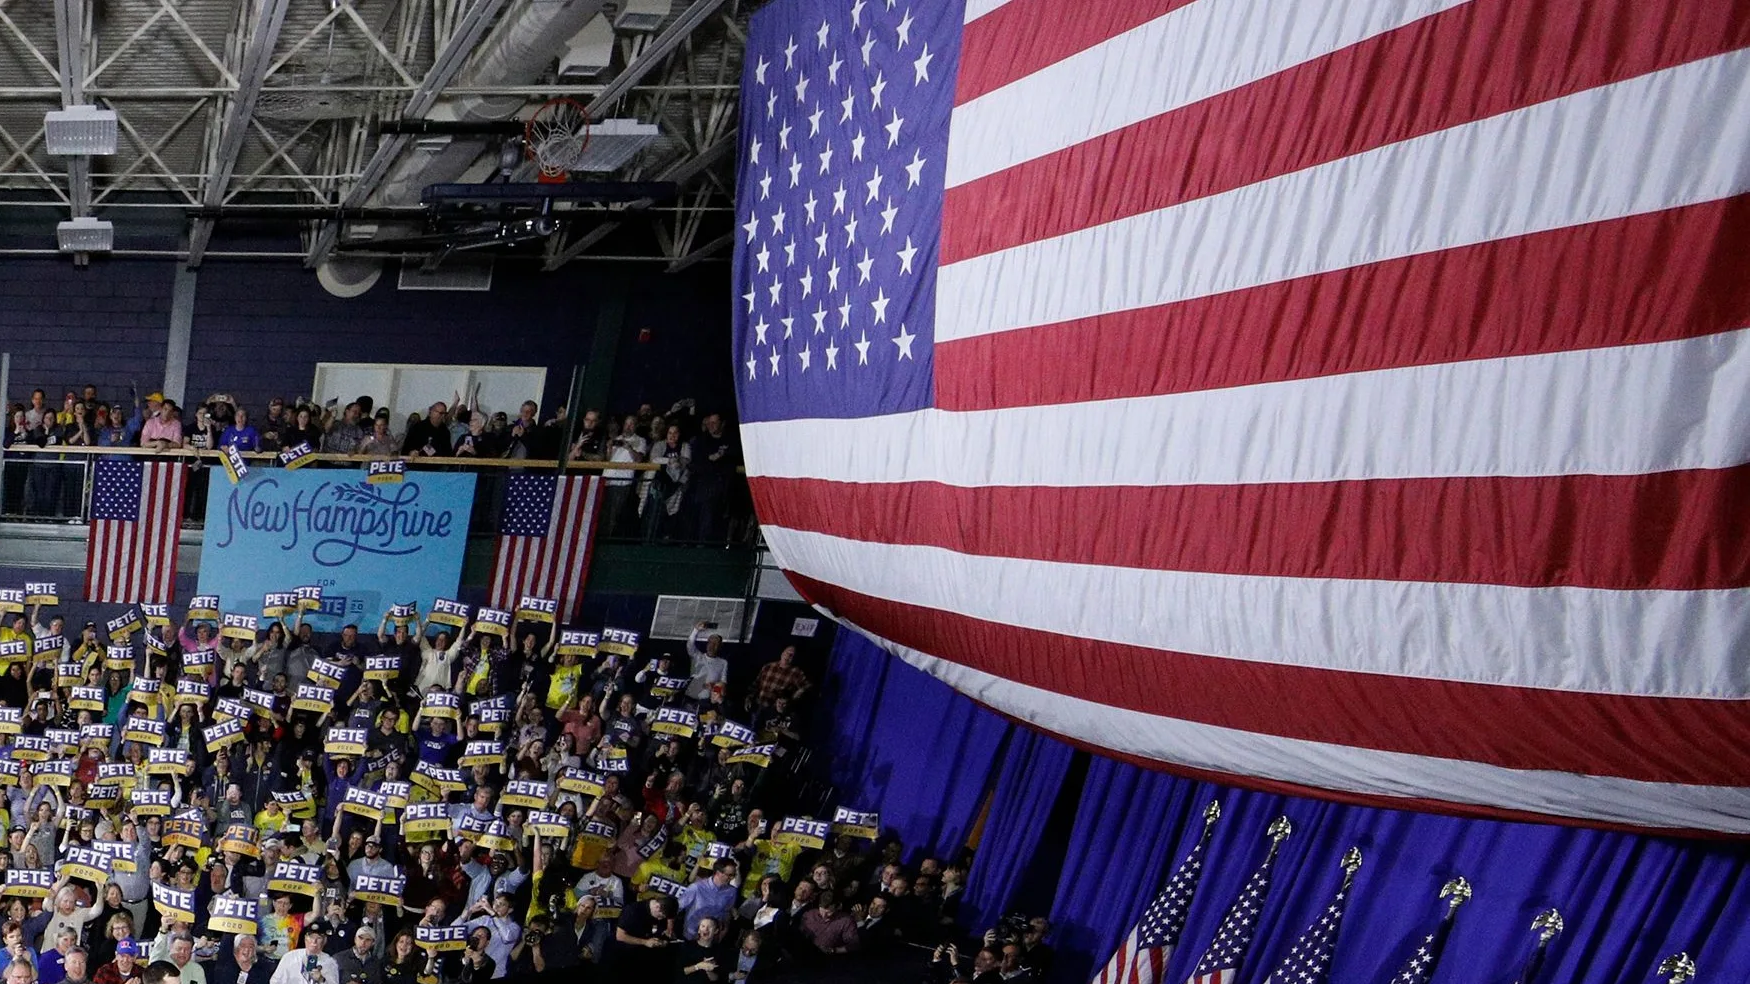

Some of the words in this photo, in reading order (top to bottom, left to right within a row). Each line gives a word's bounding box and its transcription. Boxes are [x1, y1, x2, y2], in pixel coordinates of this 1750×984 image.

[280, 443, 311, 464] PETE
[370, 461, 403, 473] PETE
[217, 479, 290, 547] New
[282, 481, 453, 566] Hampshire
[26, 583, 56, 594] PETE
[190, 596, 218, 609] PETE
[265, 594, 297, 606] PETE
[520, 597, 555, 612] PETE
[434, 599, 469, 617] PETE
[107, 610, 137, 632] PETE
[224, 614, 257, 628] PETE
[478, 608, 511, 625] PETE
[562, 632, 597, 646] PETE
[602, 628, 638, 645] PETE
[34, 636, 63, 653] PETE
[107, 645, 133, 659] PETE
[183, 652, 214, 665] PETE
[312, 659, 346, 680] PETE
[366, 657, 400, 670] PETE
[133, 677, 160, 692] PETE
[177, 680, 208, 695] PETE
[72, 686, 102, 700] PETE
[243, 688, 273, 708] PETE
[298, 685, 332, 701] PETE
[427, 693, 460, 707] PETE
[217, 699, 250, 719] PETE
[657, 709, 696, 725] PETE
[81, 724, 113, 737] PETE
[129, 718, 164, 733] PETE
[204, 719, 241, 741] PETE
[45, 730, 79, 744] PETE
[329, 729, 364, 742] PETE
[15, 737, 49, 749] PETE
[465, 743, 500, 755] PETE
[150, 750, 185, 763] PETE
[34, 761, 70, 774] PETE
[99, 763, 134, 776] PETE
[566, 767, 605, 784] PETE
[380, 782, 409, 796] PETE
[507, 781, 547, 797] PETE
[132, 791, 168, 804] PETE
[272, 791, 304, 803] PETE
[346, 788, 386, 809] PETE
[407, 804, 446, 819] PETE
[529, 811, 570, 824] PETE
[163, 821, 201, 835] PETE
[783, 819, 827, 836] PETE
[67, 848, 111, 869] PETE
[7, 871, 50, 884] PETE
[75, 867, 94, 876] 2020
[274, 862, 319, 882] PETE
[355, 875, 400, 894] PETE
[650, 876, 686, 897] PETE
[153, 882, 192, 909] PETE
[214, 899, 257, 917] PETE
[222, 922, 243, 930] 2020
[417, 927, 465, 941] PETE
